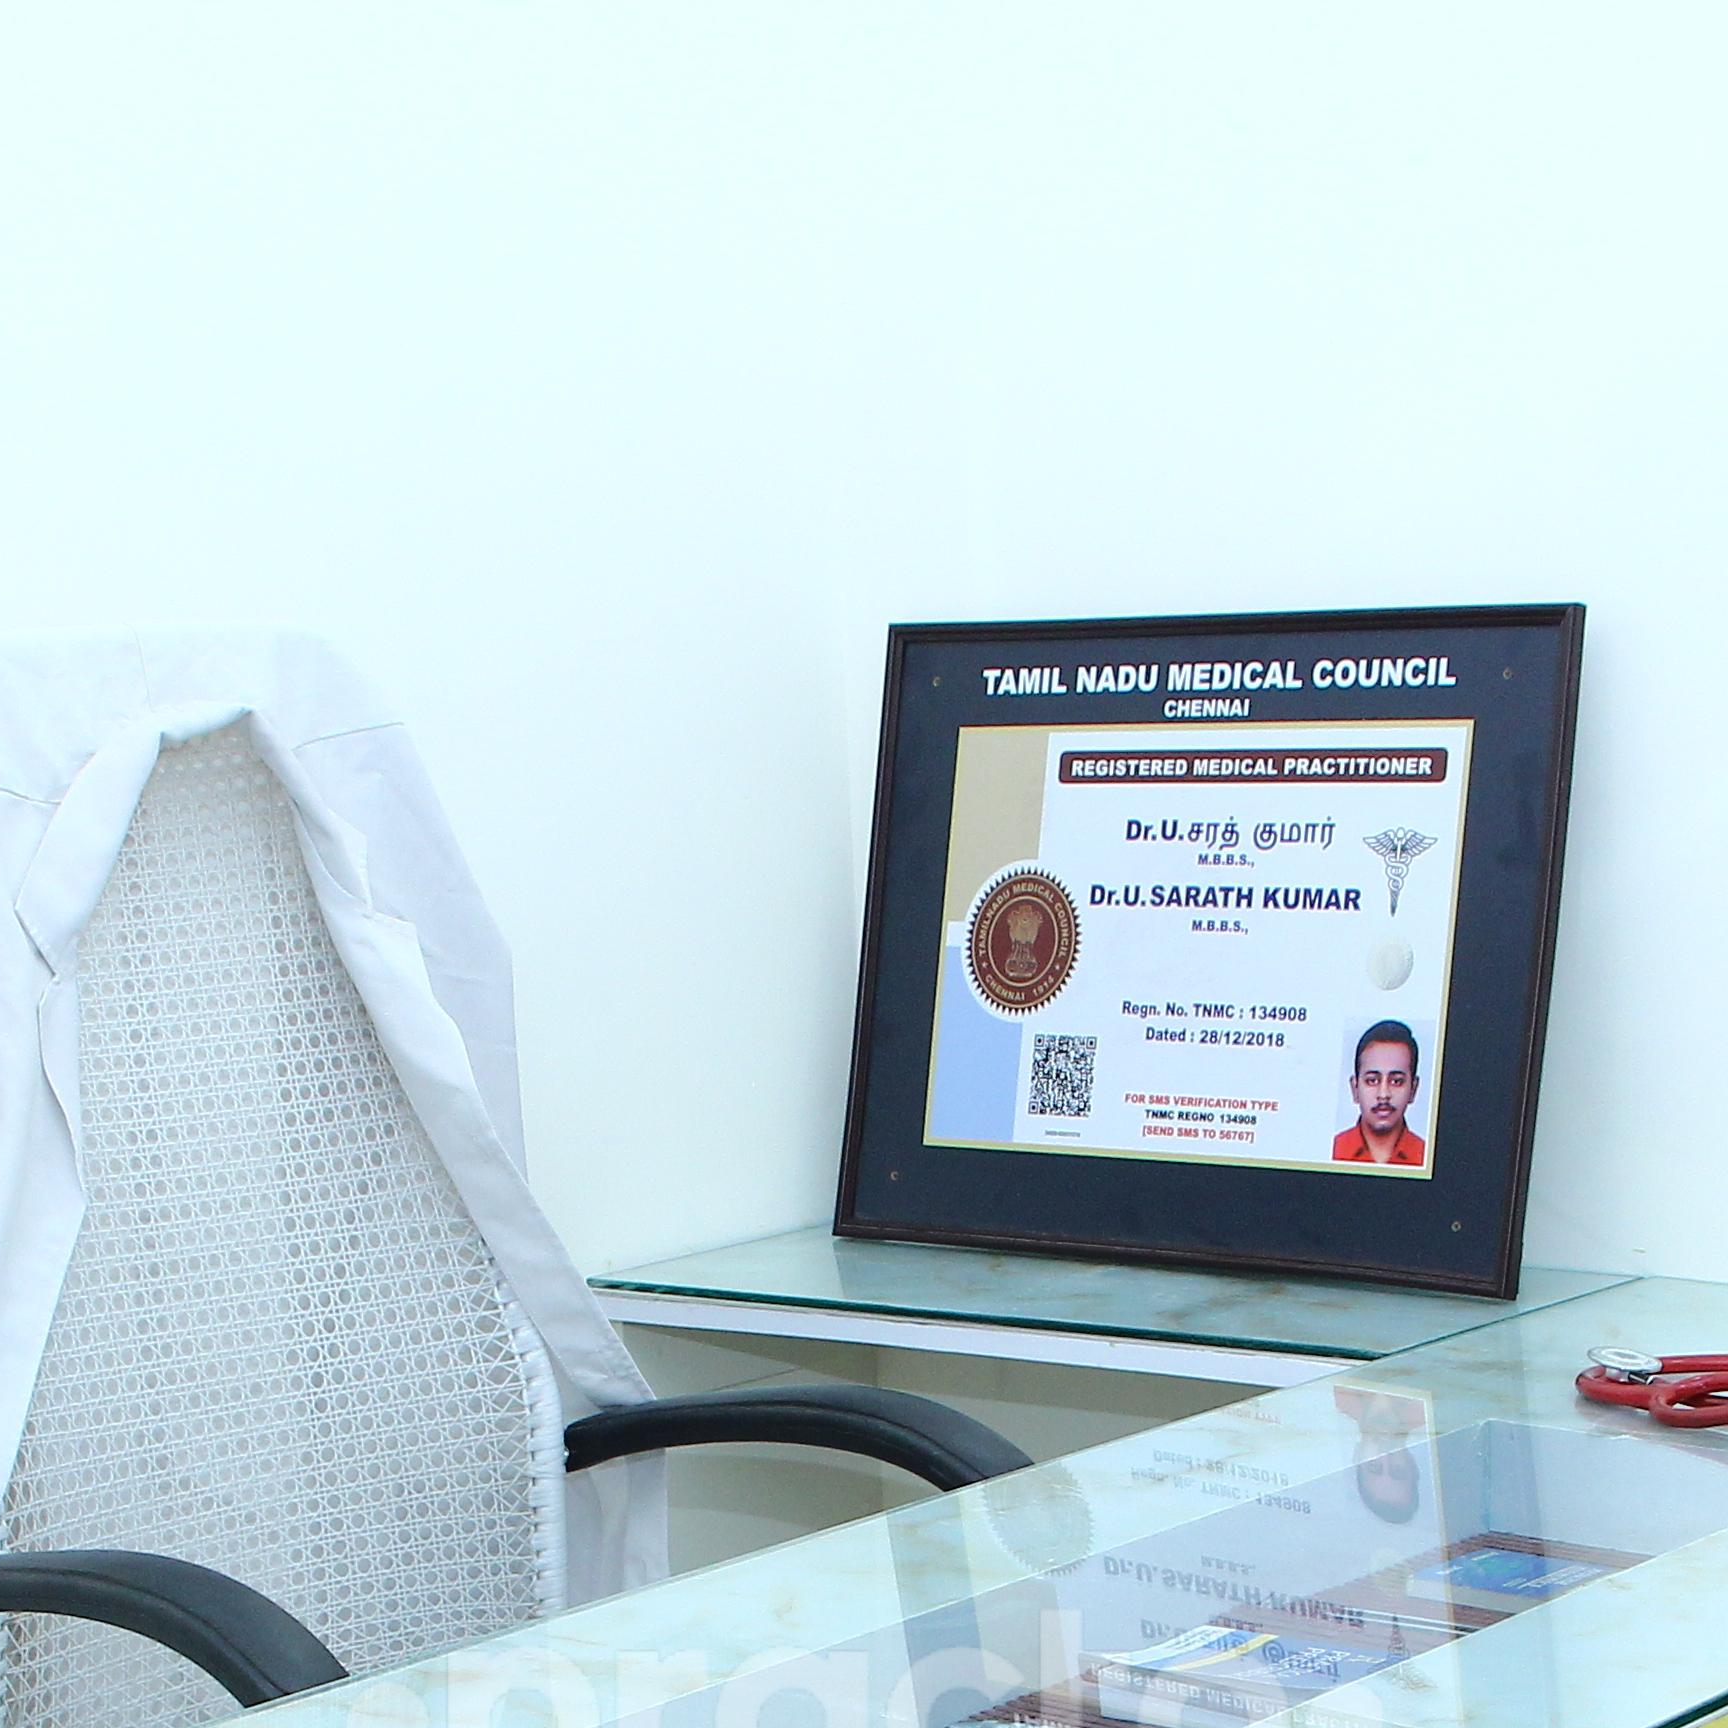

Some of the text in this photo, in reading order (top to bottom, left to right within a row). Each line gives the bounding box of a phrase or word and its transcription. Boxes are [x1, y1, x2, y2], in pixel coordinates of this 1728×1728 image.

[982, 657, 1457, 695] TAMIL NADU MEDICAL COUNCIL
[1164, 698, 1250, 718] CHENNAI
[1072, 757, 1432, 777] REGISTERED MEDICAL PRACTITIONER
[1253, 816, 1336, 850] குமார்
[1263, 887, 1361, 911] KUMAR
[1013, 882, 1055, 903] MEDICAL
[1054, 902, 1070, 957] COUNCIL
[985, 975, 1025, 1001] CHENNAI
[1122, 1000, 1161, 1018] Regn.
[1165, 1002, 1188, 1017] No.
[1193, 1003, 1235, 1019] TNMC
[1249, 1006, 1307, 1022] 134908
[1145, 1026, 1186, 1043] Dated
[1199, 1029, 1285, 1047] 28/12/2018
[1125, 1093, 1279, 1112] FOR SMS VERIFICATION TYPE
[1145, 1109, 1257, 1125] TNMC REGNO 134908
[1177, 1127, 1200, 1138] SMS
[1202, 1128, 1217, 1139] TO
